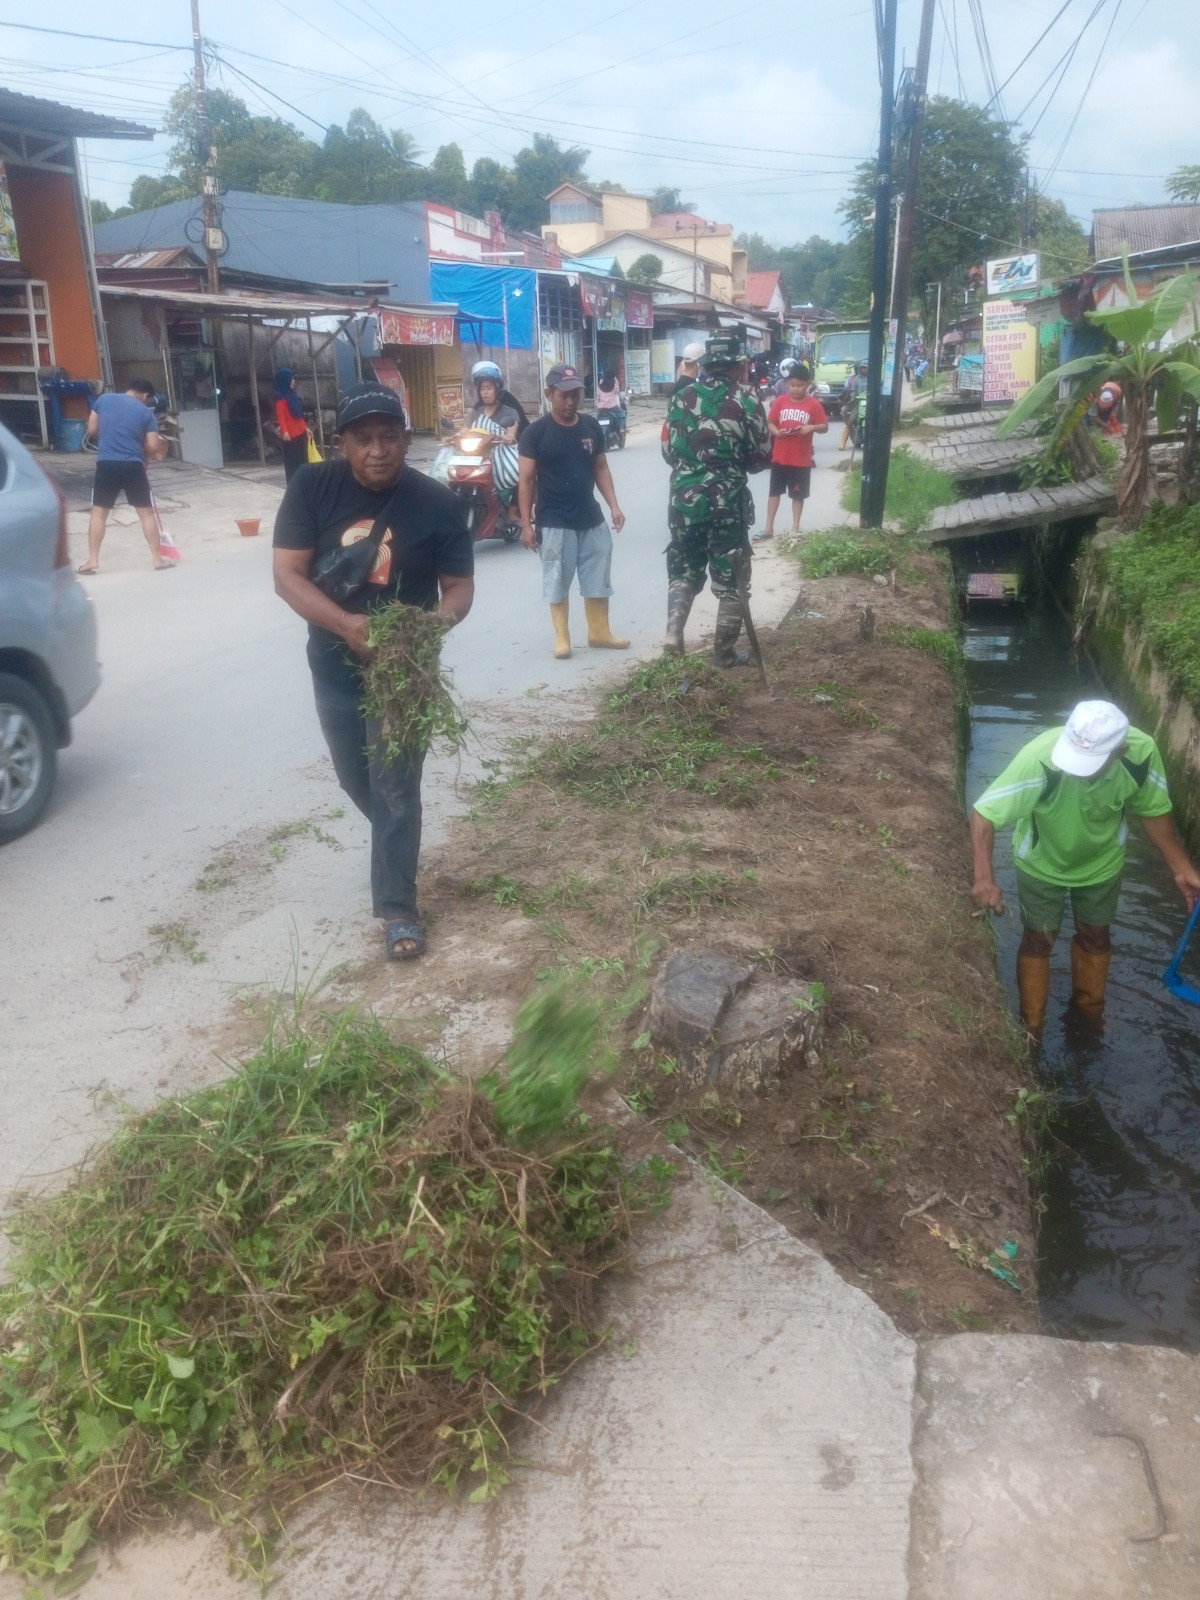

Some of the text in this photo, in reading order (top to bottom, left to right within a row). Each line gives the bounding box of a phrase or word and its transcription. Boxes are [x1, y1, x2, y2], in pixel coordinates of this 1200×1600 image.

[986, 332, 1027, 343] CETAK FOTO
[986, 342, 1022, 353] SEPANDUK
[985, 353, 1010, 362] STIKER
[985, 363, 1012, 372] POSTER
[985, 372, 1016, 381] STEMPEL
[985, 380, 1030, 391] KARTU NAMA
[780, 408, 810, 425] JORDAN
